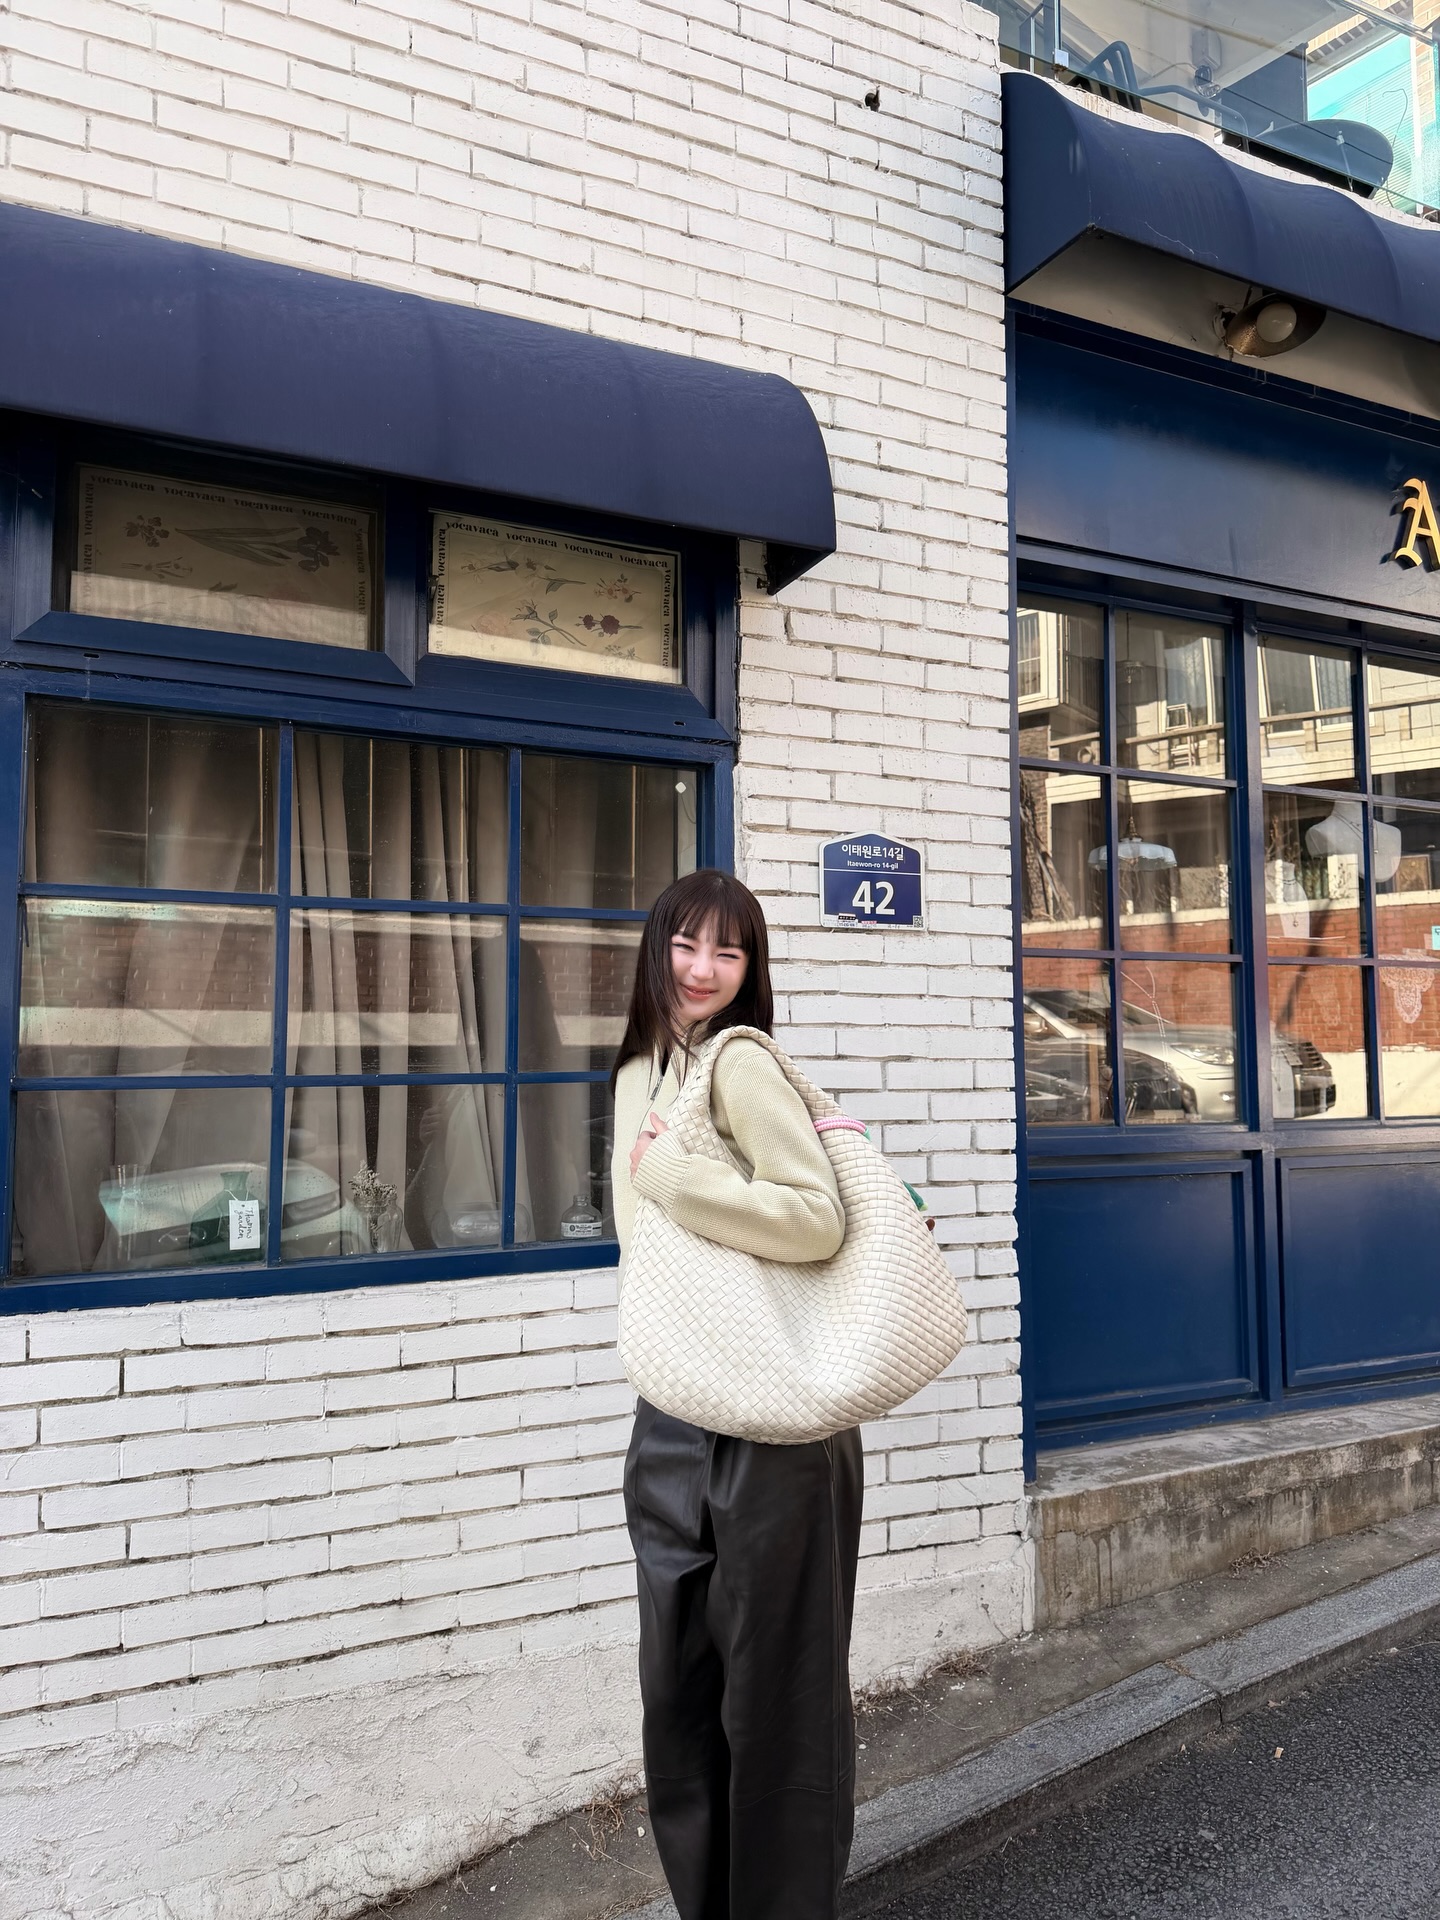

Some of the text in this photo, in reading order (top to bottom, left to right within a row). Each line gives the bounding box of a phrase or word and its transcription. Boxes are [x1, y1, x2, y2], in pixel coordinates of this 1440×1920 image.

[90, 474, 358, 526] vocavaca vocavaca vocavaca vocavaca
[436, 528, 446, 577] vocavaca
[445, 521, 668, 568] vocavaca vocavaca vocavaca vocavaca
[663, 569, 672, 617] vocavaca
[841, 844, 904, 861] 이태원로14길
[847, 860, 899, 871] Itaewon-ro 14-gil
[852, 880, 895, 915] 42
